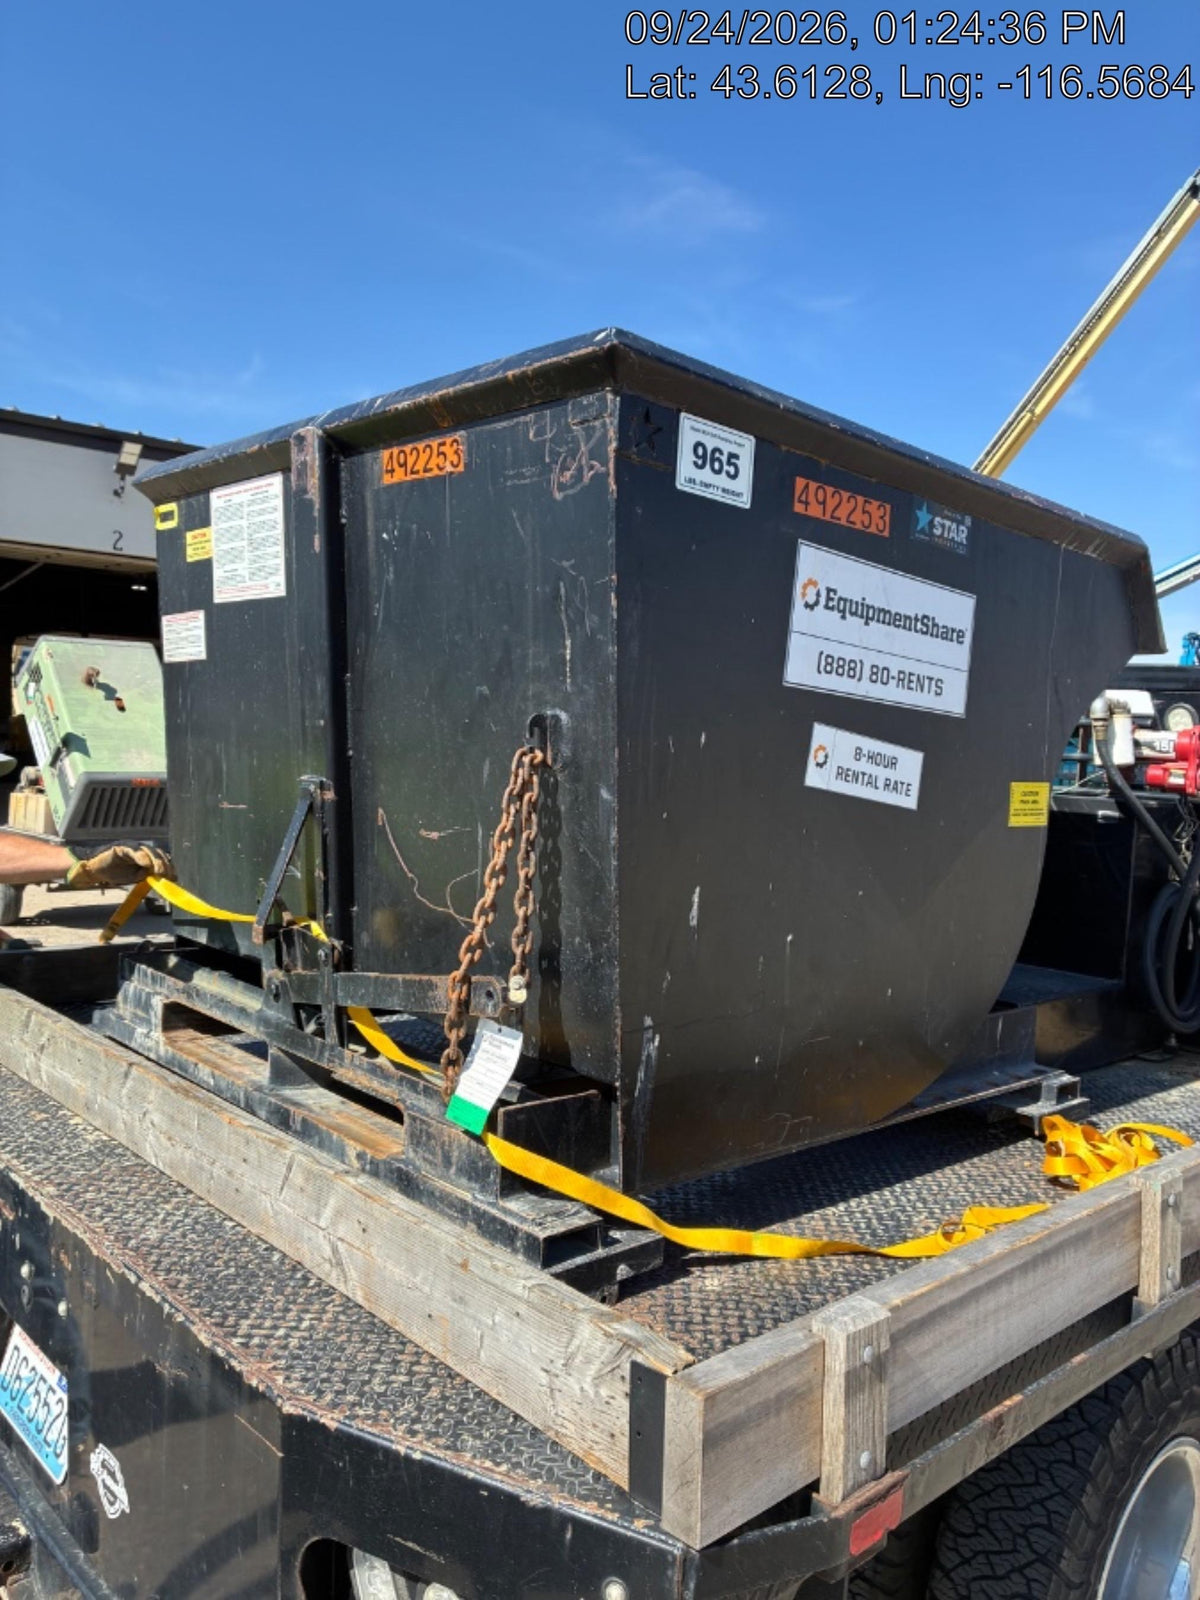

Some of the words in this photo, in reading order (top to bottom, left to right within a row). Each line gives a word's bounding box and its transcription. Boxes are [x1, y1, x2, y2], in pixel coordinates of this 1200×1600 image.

[384, 437, 462, 480] 492253
[692, 440, 741, 480] 965
[796, 480, 888, 534] 492253
[112, 530, 124, 552] 2
[932, 516, 968, 545] STAR
[823, 585, 968, 646] EquipmentShare
[816, 650, 864, 683] (888)
[869, 664, 945, 698] 80-RENTS
[853, 746, 898, 772] 8-HOUR
[835, 766, 880, 790] RENTAL
[883, 777, 912, 798] RATE
